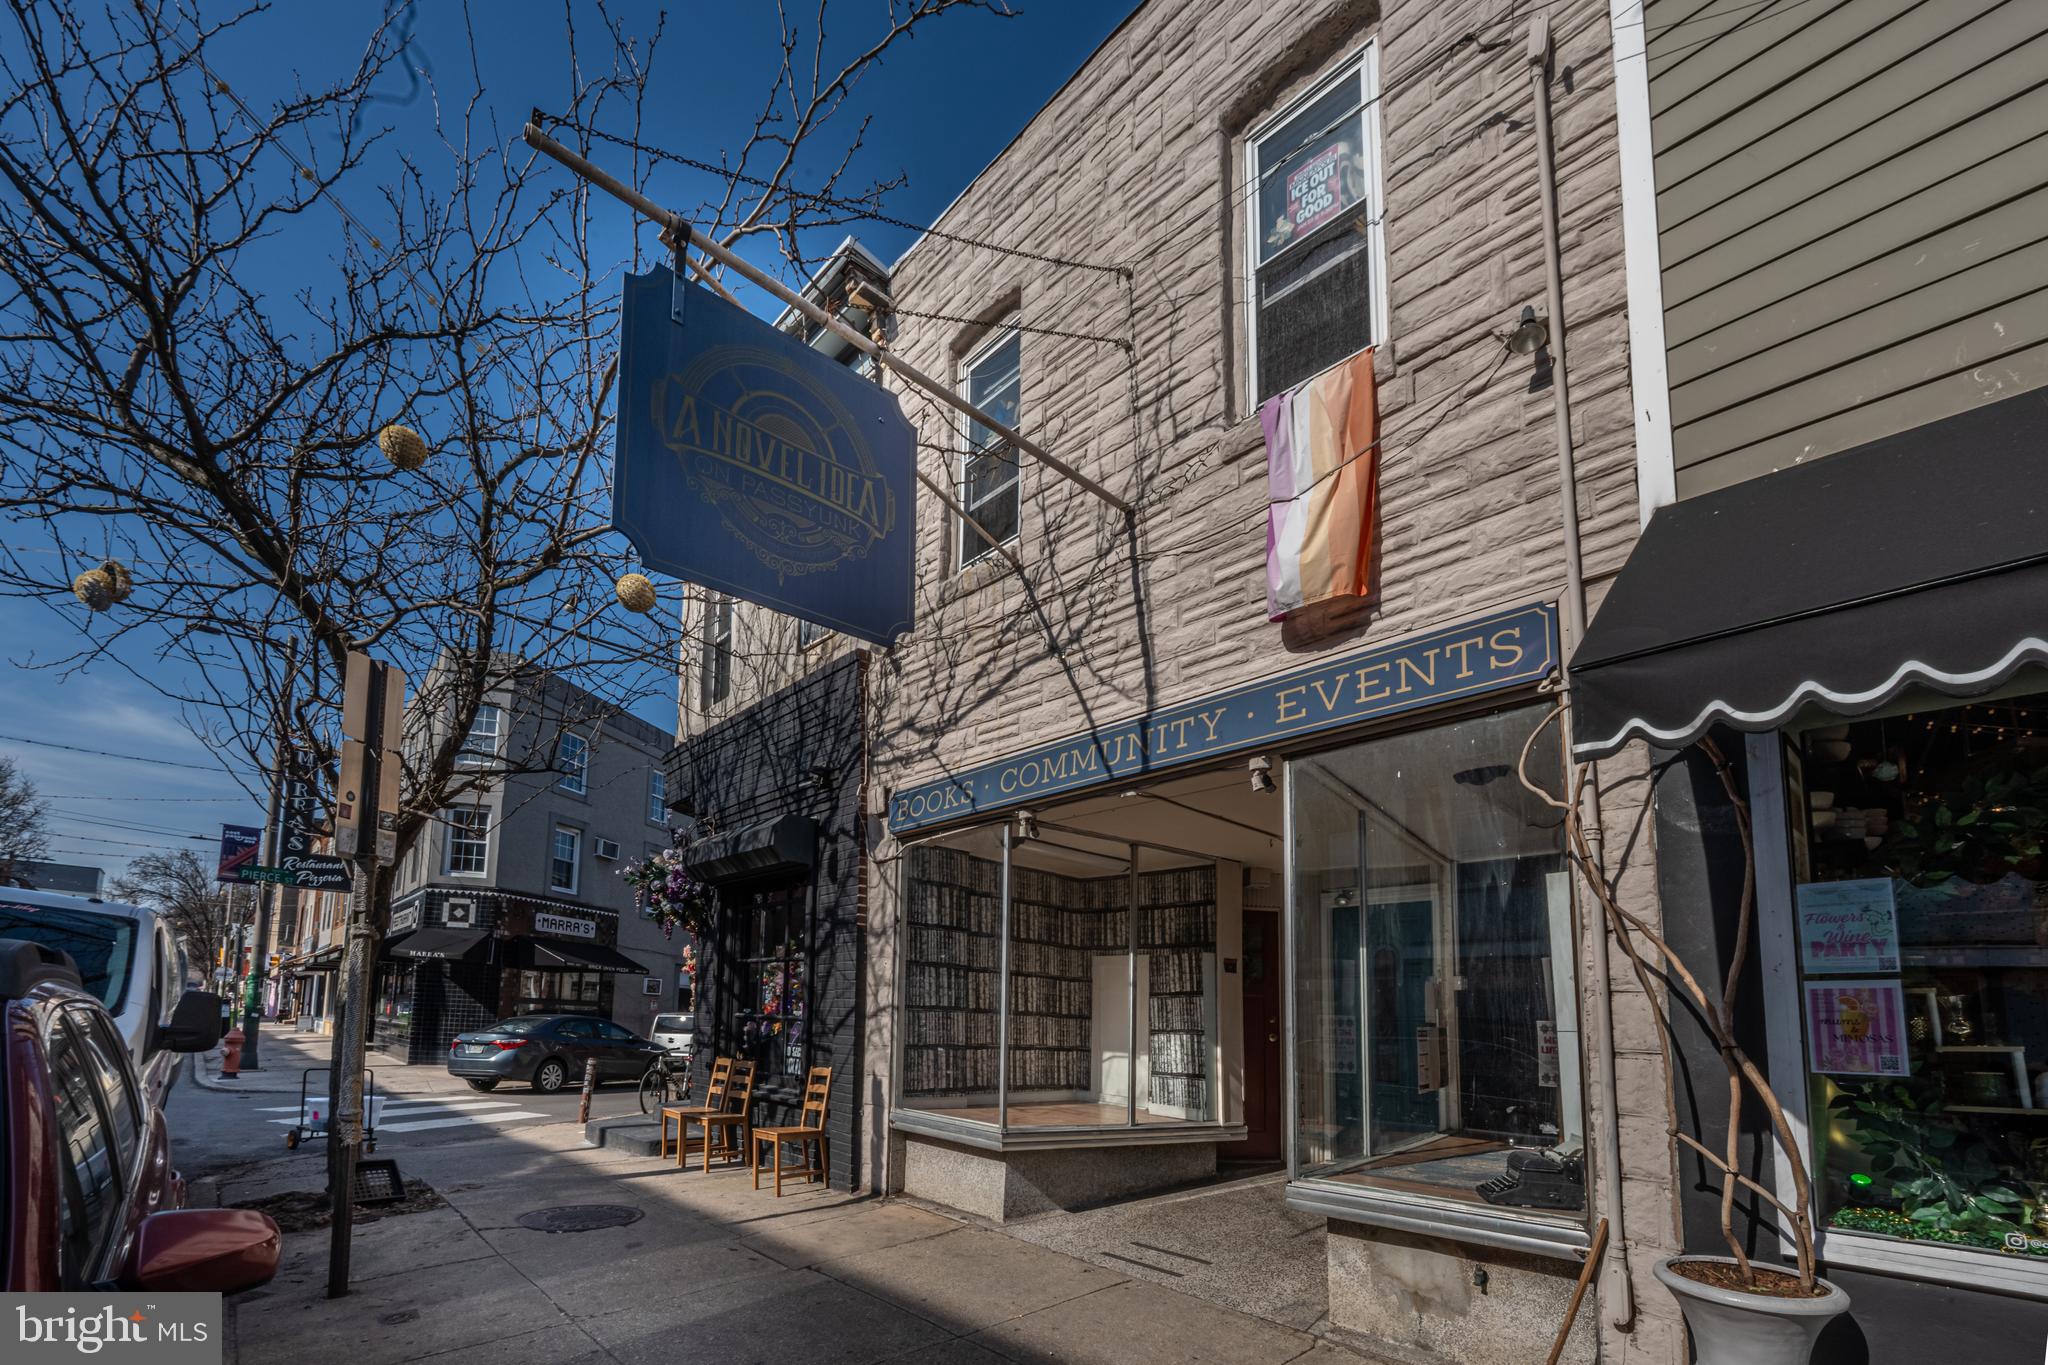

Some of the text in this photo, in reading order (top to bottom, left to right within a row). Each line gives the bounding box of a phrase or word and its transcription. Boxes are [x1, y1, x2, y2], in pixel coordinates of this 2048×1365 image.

[1291, 179, 1309, 202] ICE
[1309, 161, 1335, 188] OUT
[1301, 183, 1327, 209] FOR
[1295, 192, 1333, 224] GOOD
[671, 394, 881, 528] A NOVEL IDEA
[694, 455, 863, 540] ON PASSYUNK
[895, 627, 1524, 822] BOOKS COMMUNITY EVENTS
[241, 869, 281, 882] PIERCE
[296, 870, 344, 887] Pizzeria
[541, 917, 591, 934] MARRA'S
[1804, 911, 1866, 925] Flowers
[1810, 938, 1888, 958] PARTY
[1823, 930, 1872, 945] Wine
